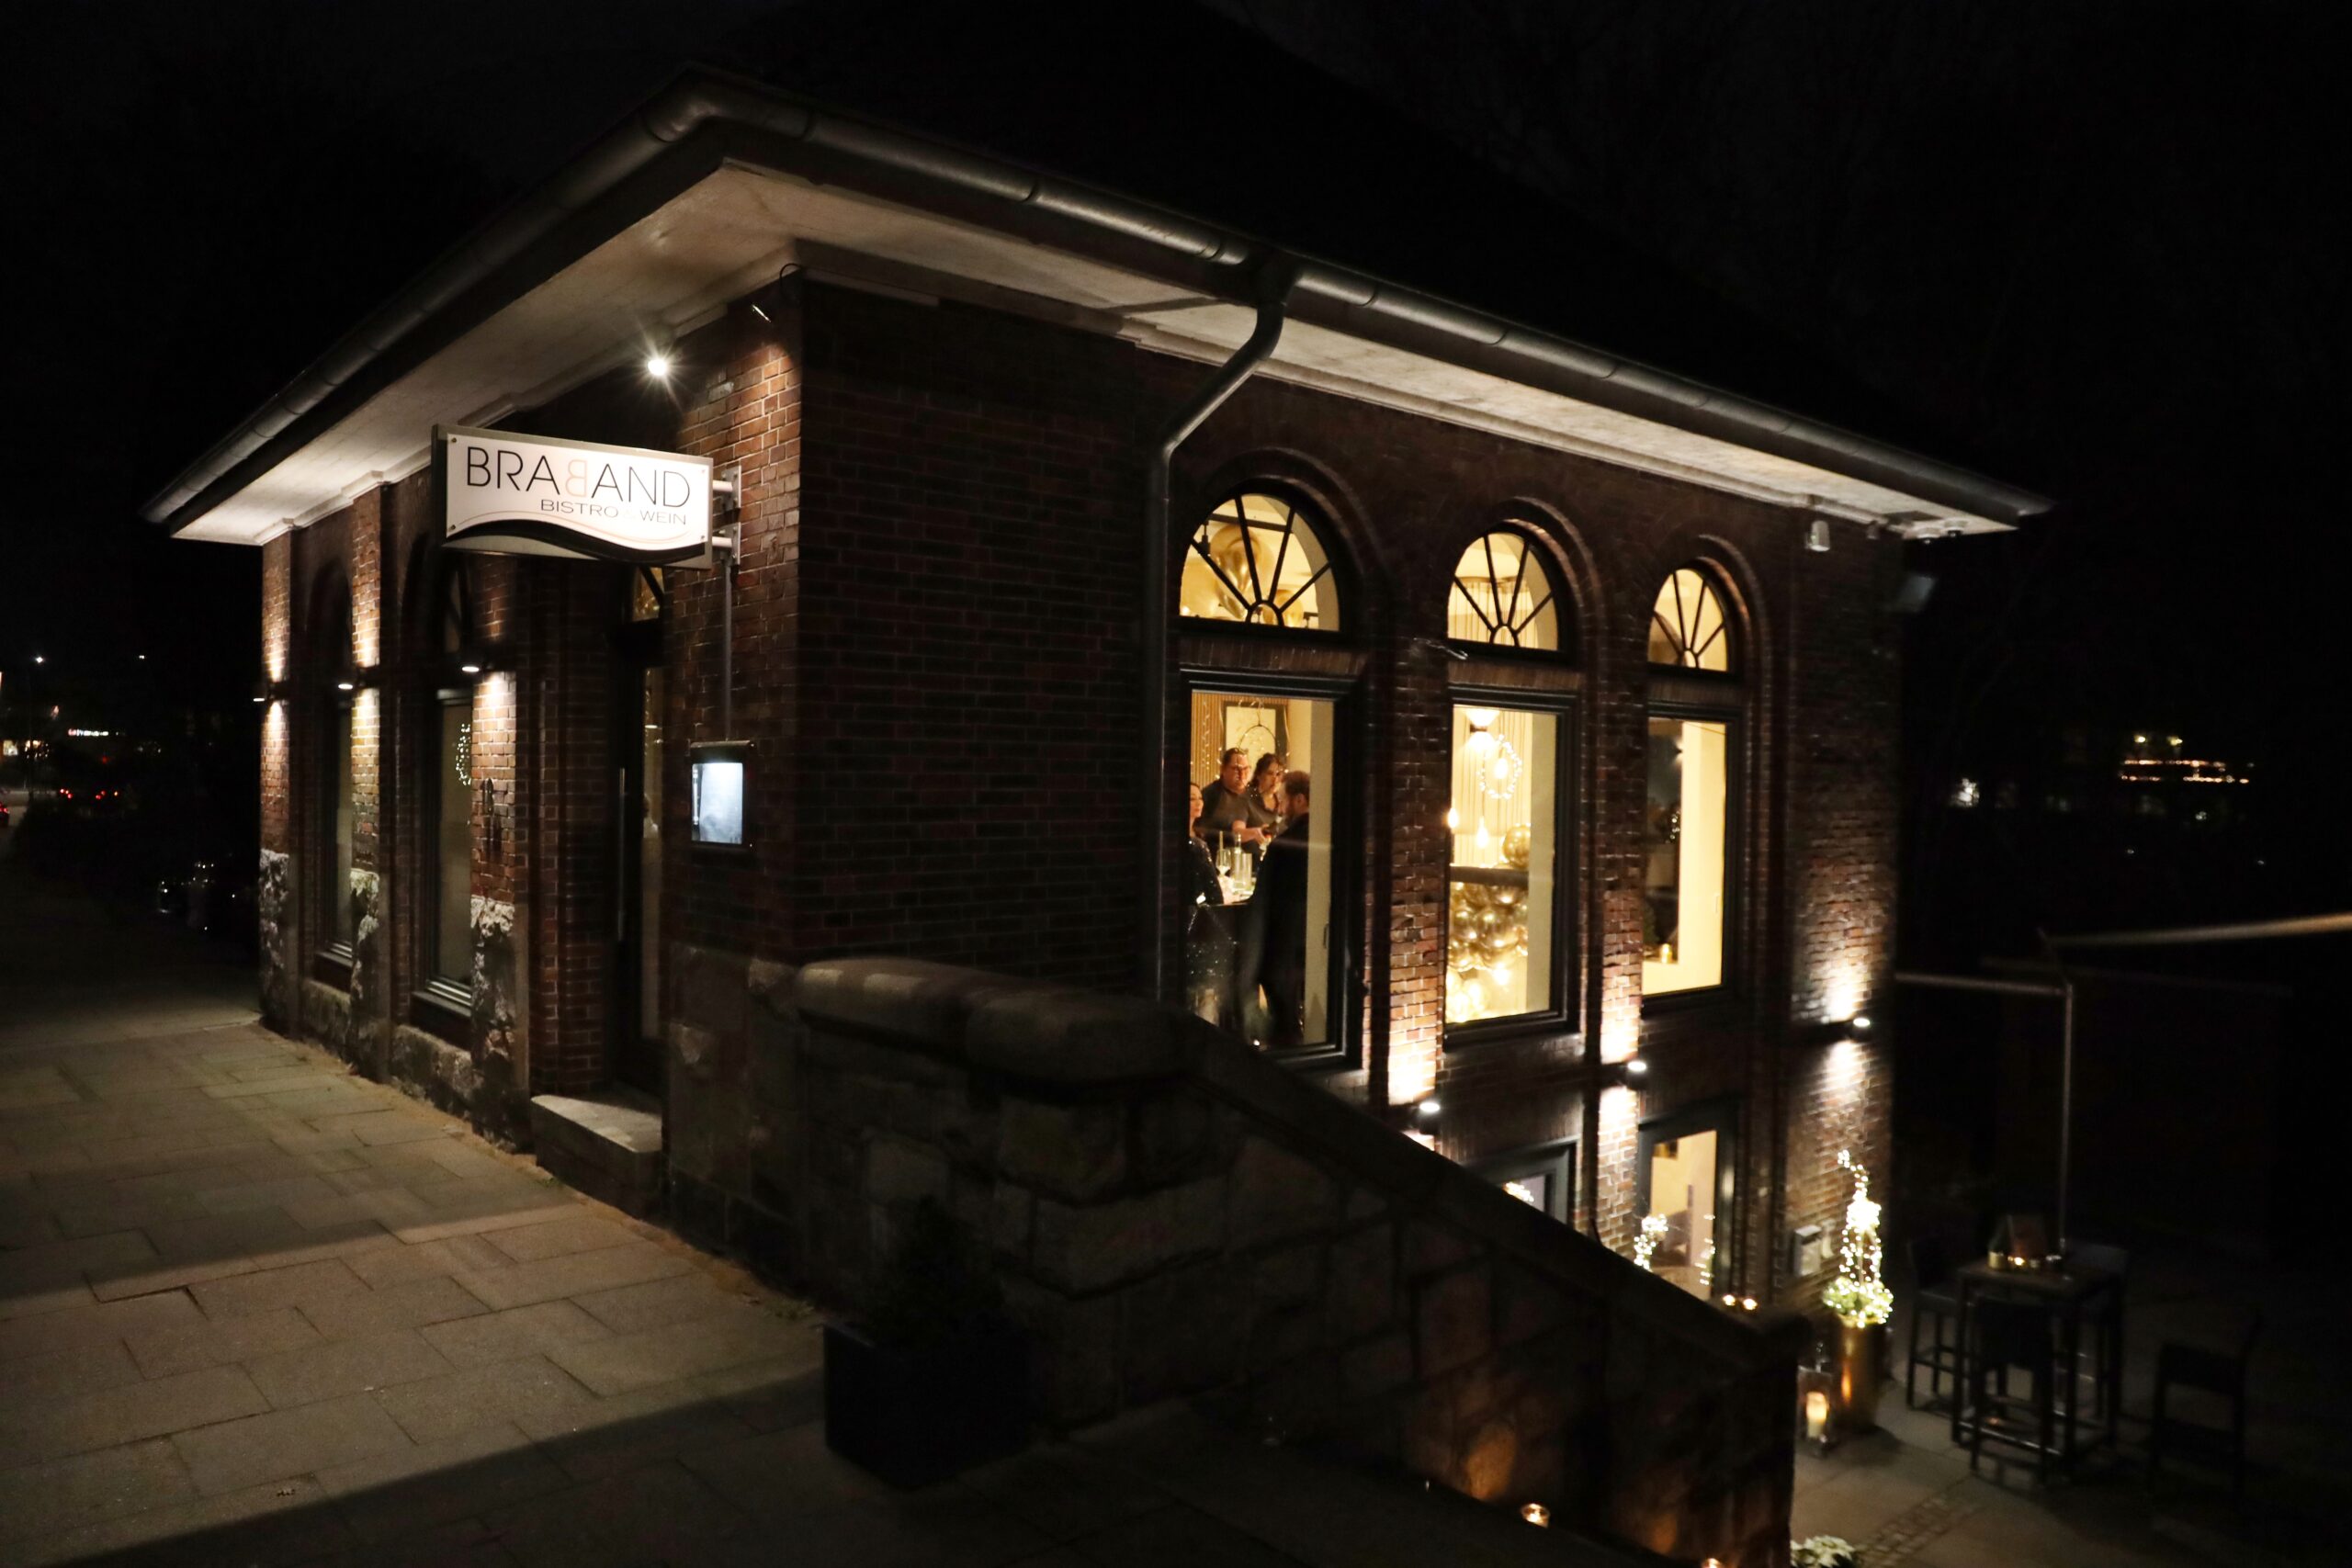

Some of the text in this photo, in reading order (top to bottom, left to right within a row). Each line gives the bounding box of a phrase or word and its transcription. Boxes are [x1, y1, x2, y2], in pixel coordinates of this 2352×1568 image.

[467, 446, 690, 507] BRABAND
[540, 499, 619, 518] BISTRO
[639, 510, 686, 525] WEIN
